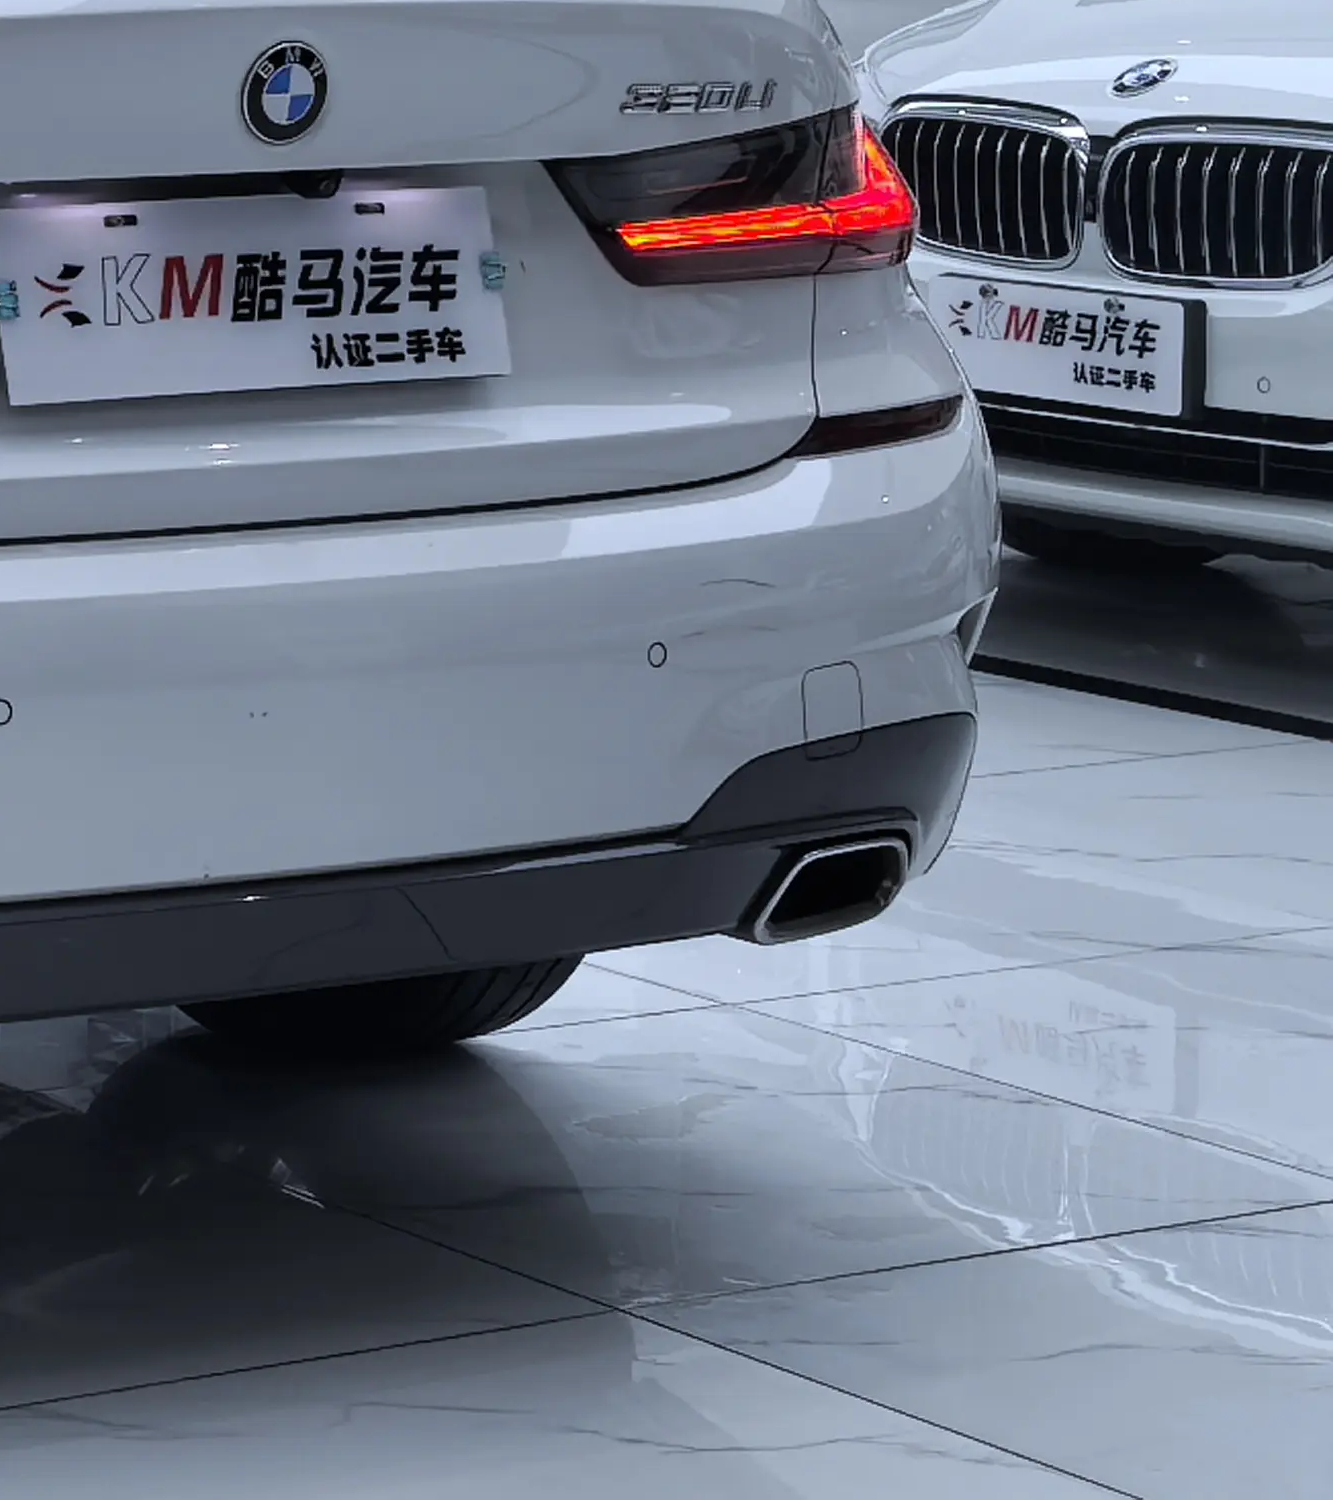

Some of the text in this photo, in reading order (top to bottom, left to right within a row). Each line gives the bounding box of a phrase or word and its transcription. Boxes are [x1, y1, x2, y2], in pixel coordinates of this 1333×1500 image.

[256, 46, 325, 80] BMW
[310, 327, 467, 370] 认证二手车
[1072, 362, 1157, 393] 认证二手车
